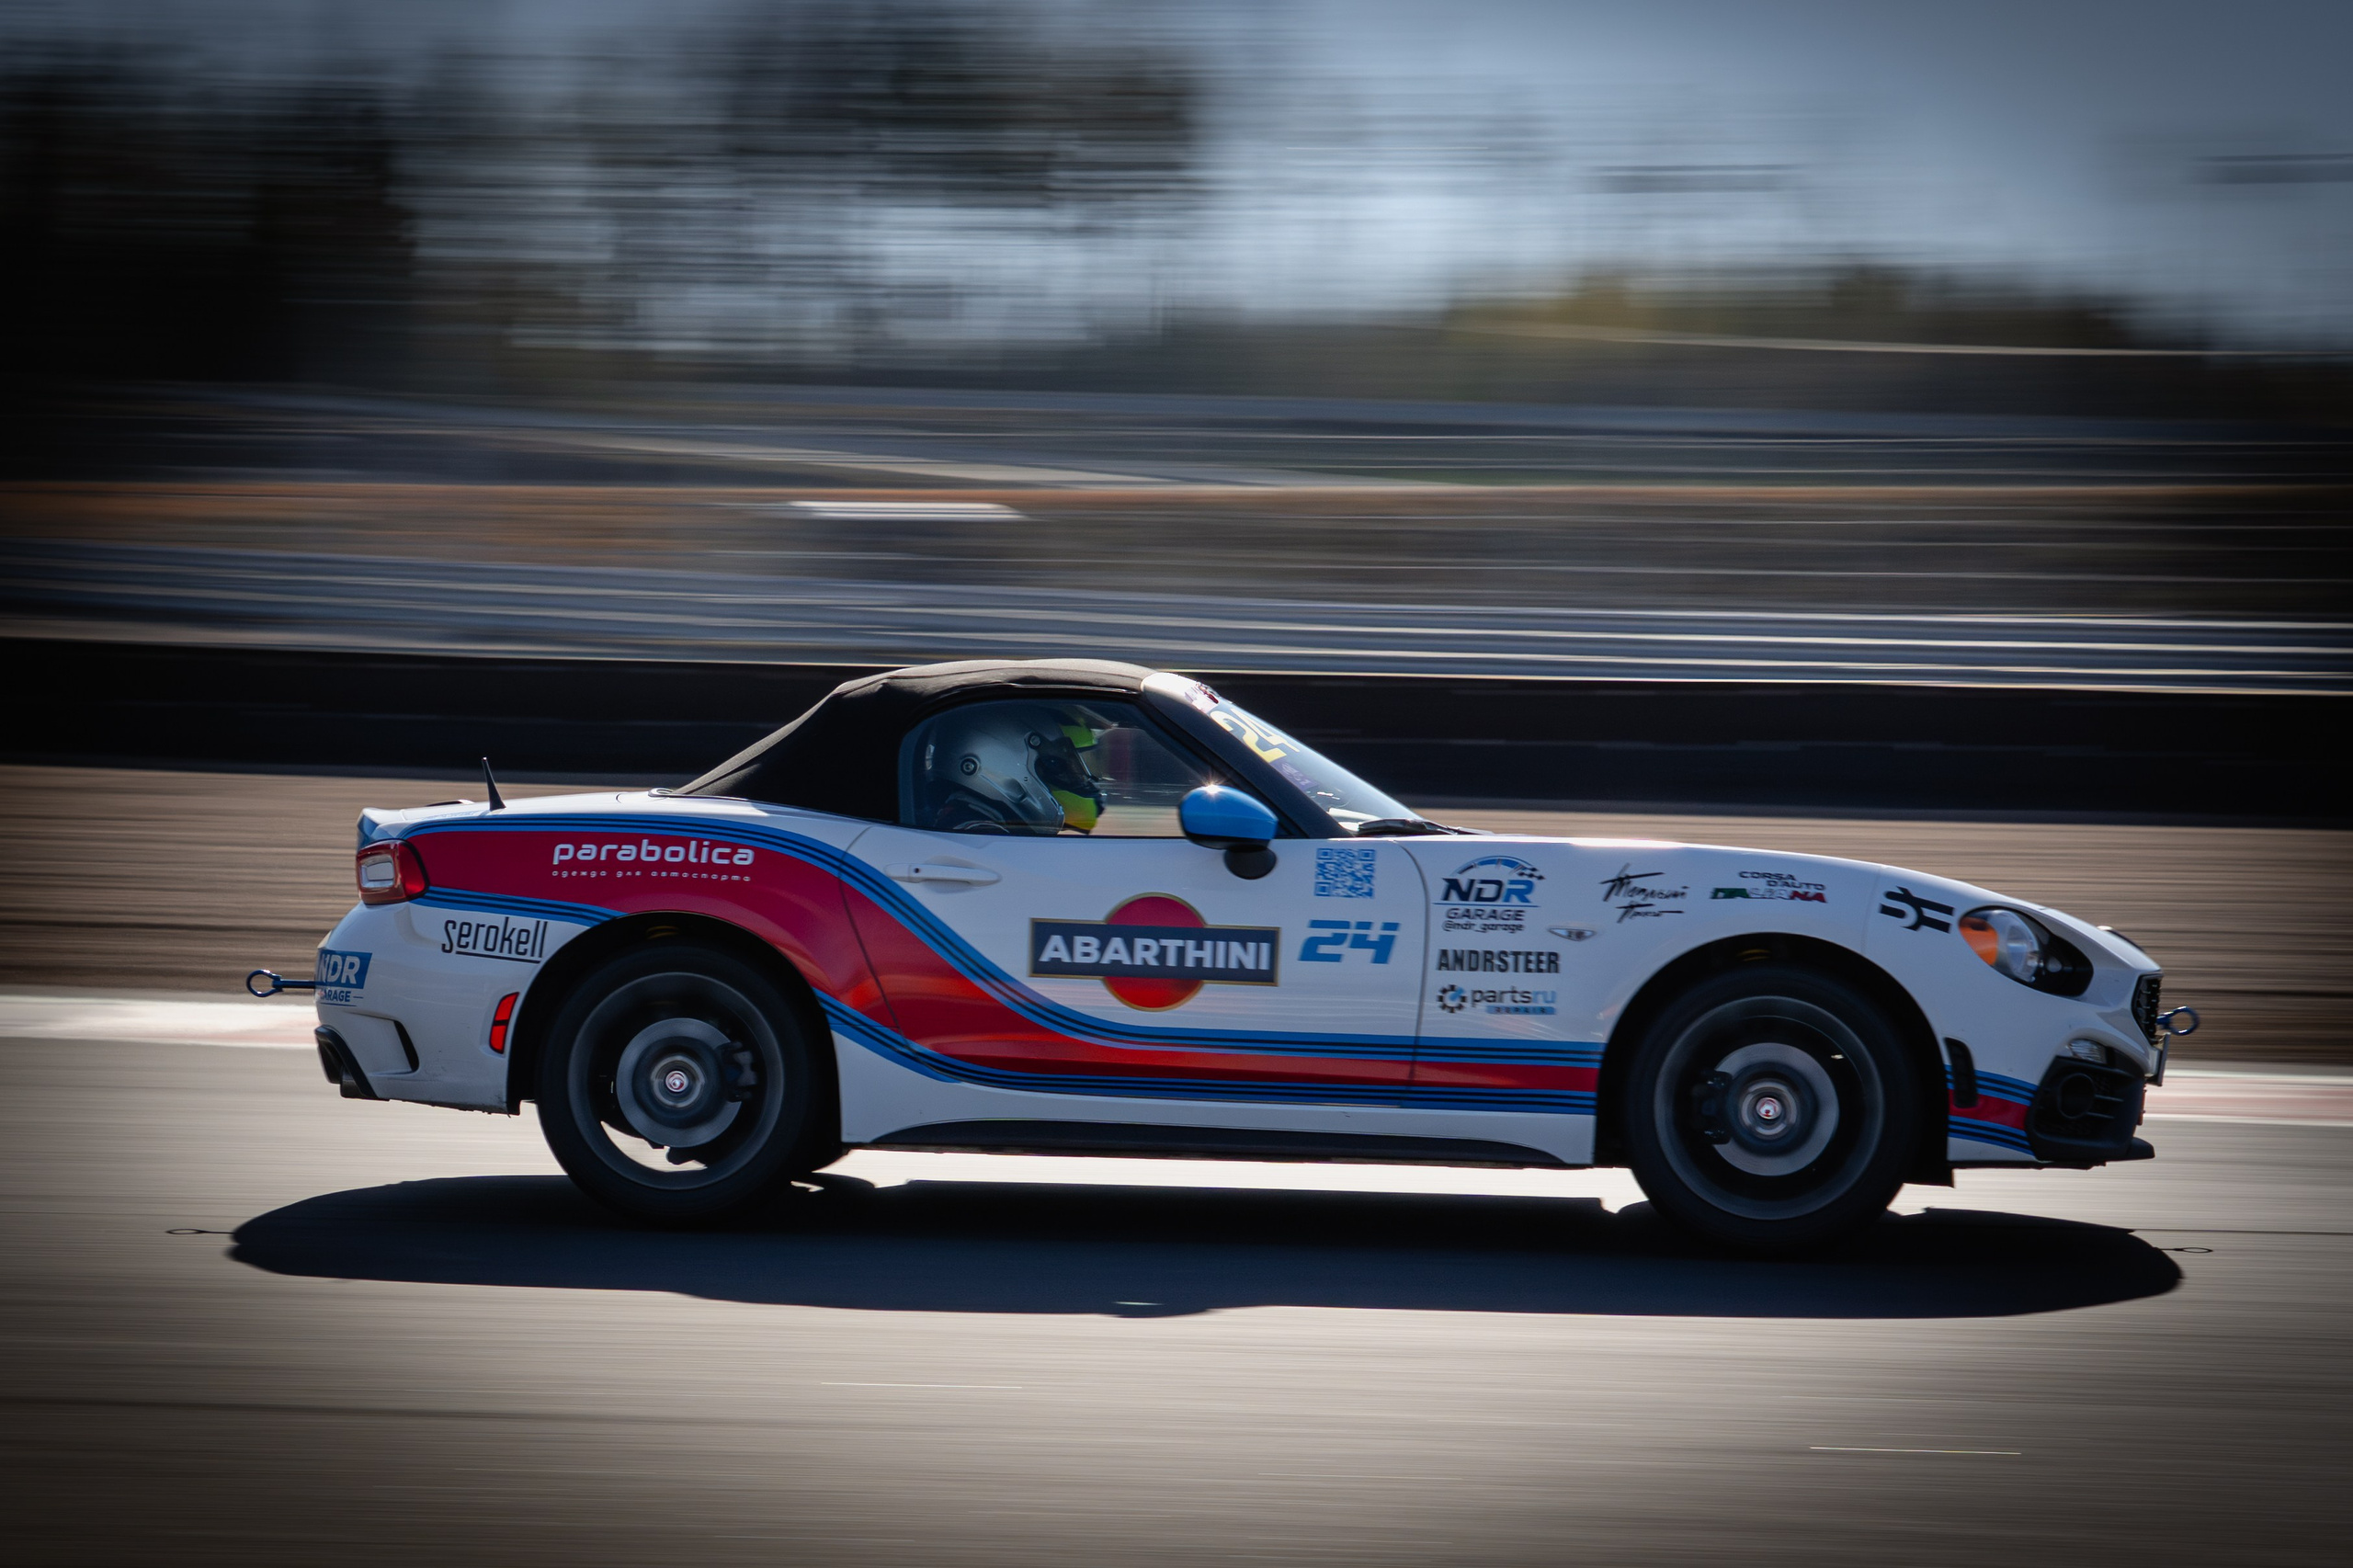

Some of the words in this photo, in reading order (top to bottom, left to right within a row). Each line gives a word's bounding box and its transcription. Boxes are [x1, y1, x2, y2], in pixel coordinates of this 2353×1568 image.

[1210, 708, 1301, 764] 24
[552, 839, 755, 866] parabolica
[1738, 870, 1798, 881] CORSA
[1441, 878, 1536, 903] NDR
[1446, 908, 1526, 921] GARAGE
[1039, 934, 1272, 971] ABARTHINI
[1297, 919, 1402, 965] 24
[320, 953, 360, 984] NDR
[1438, 949, 1560, 973] ANDRSTEER
